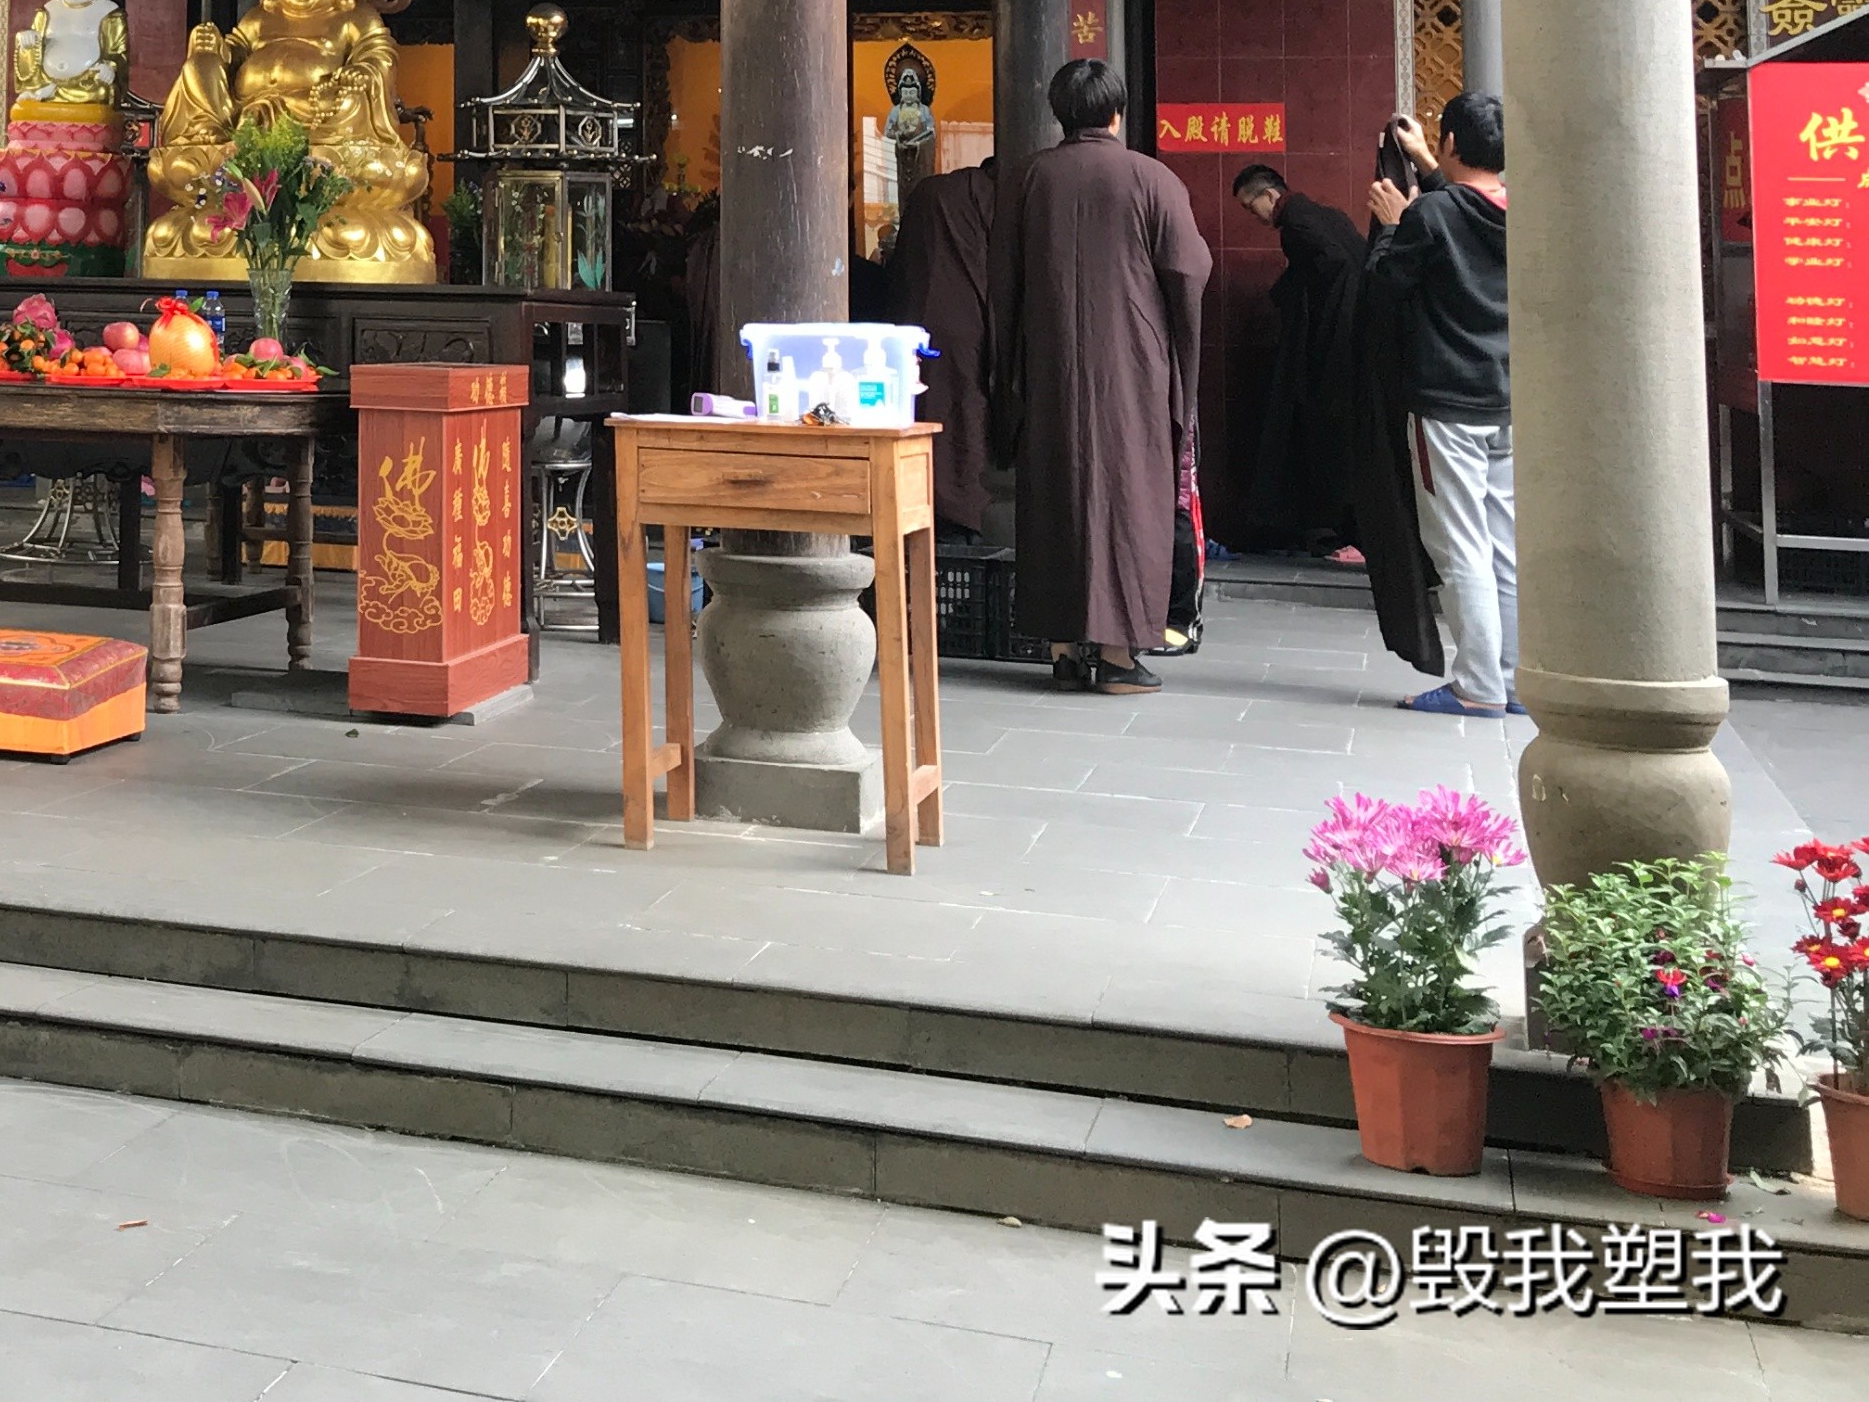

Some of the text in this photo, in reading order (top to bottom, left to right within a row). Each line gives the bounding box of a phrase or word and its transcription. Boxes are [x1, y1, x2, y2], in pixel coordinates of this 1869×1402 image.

[1159, 111, 1285, 147] 入殿请脱鞋
